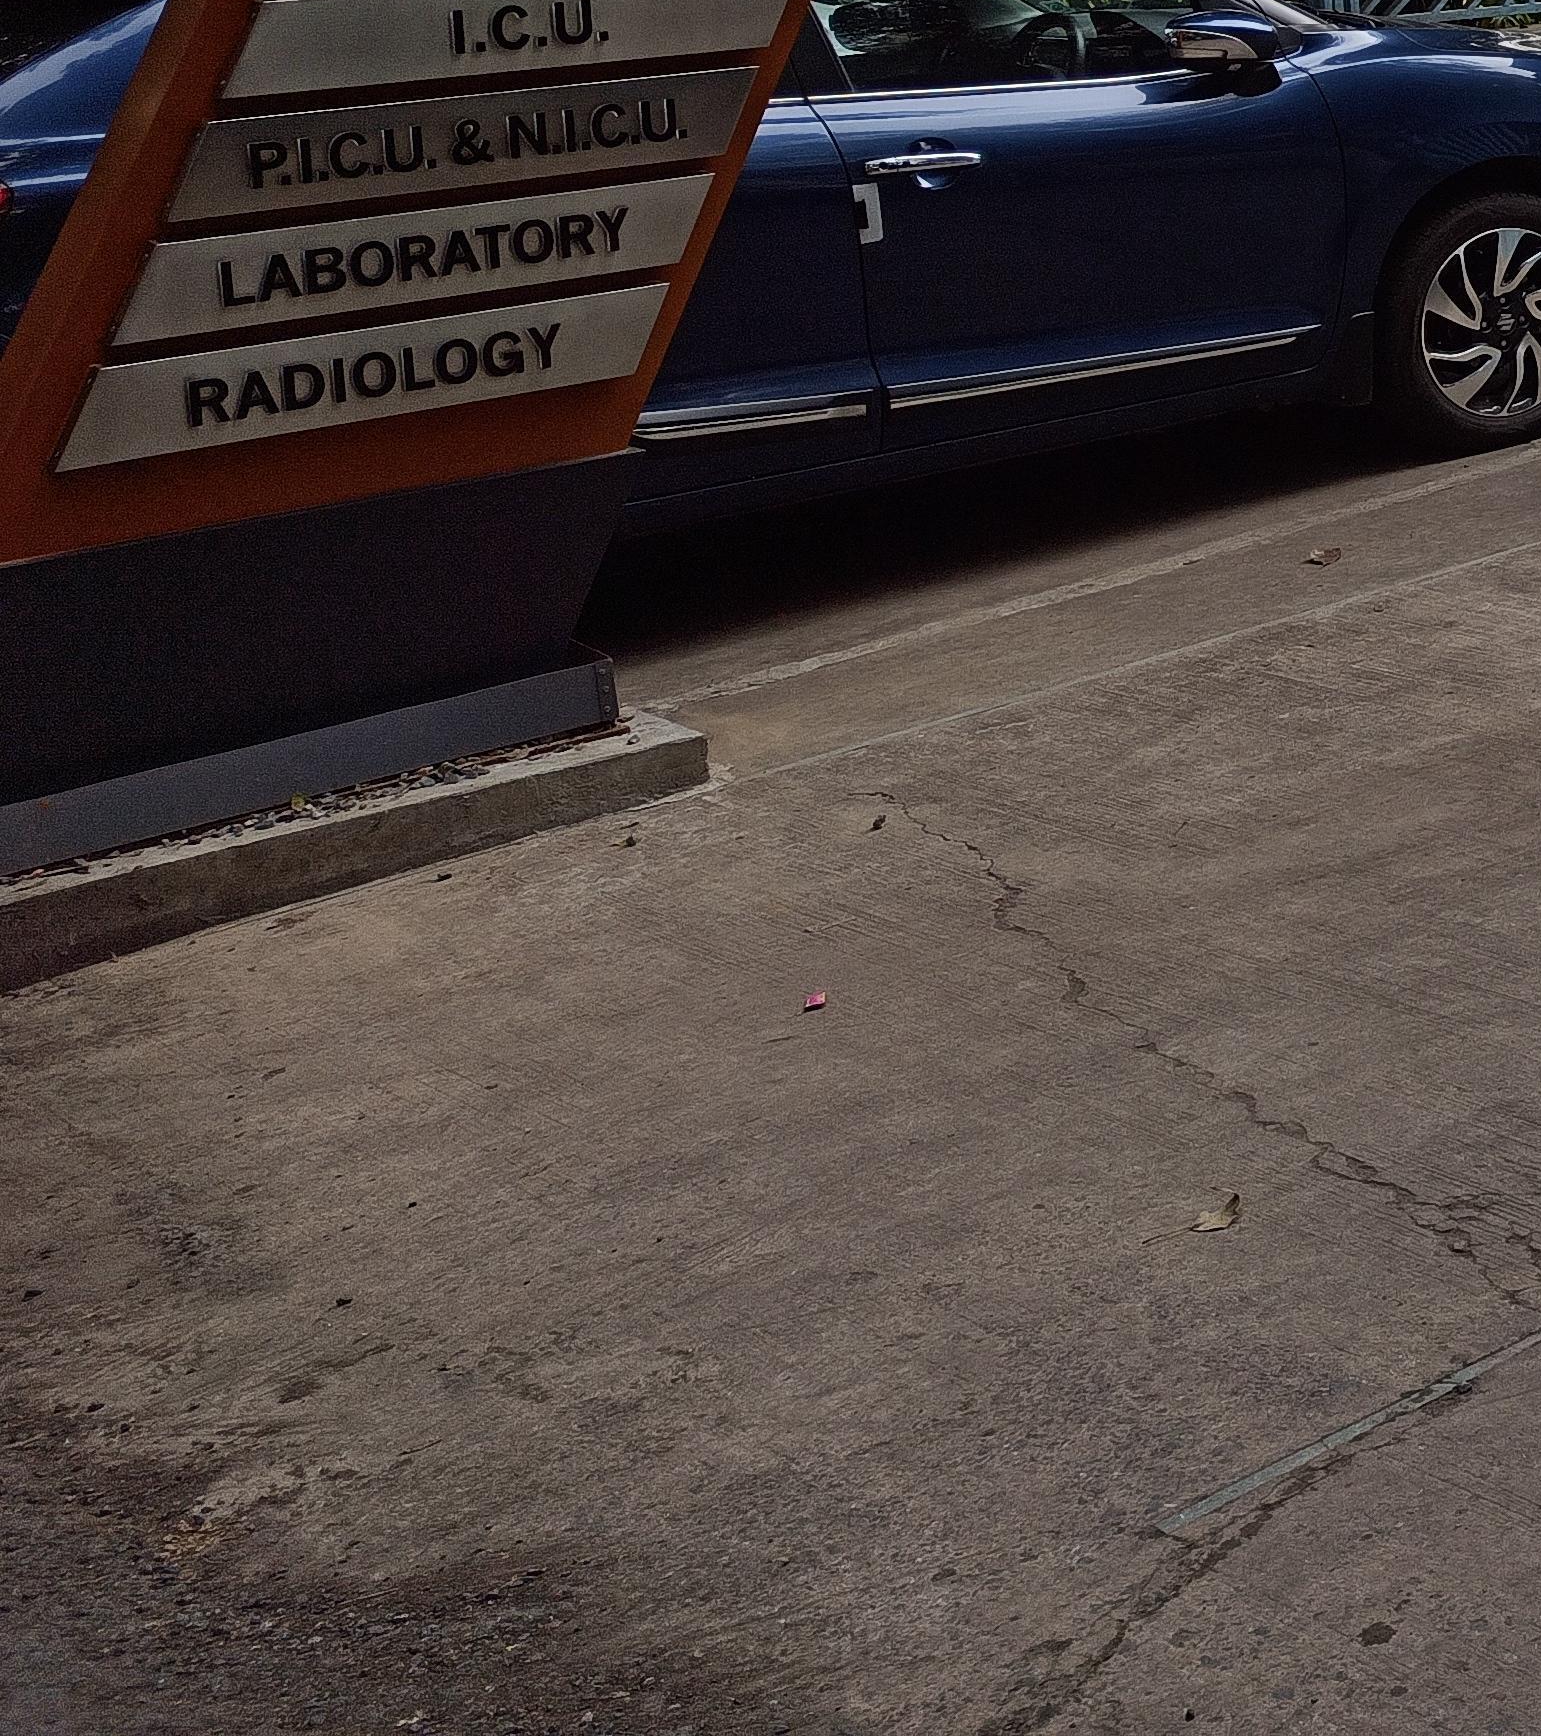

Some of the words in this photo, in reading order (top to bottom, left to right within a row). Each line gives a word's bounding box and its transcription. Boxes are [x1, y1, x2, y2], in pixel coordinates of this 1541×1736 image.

[246, 124, 438, 190] P.I.C.U.
[450, 117, 495, 165] &
[505, 97, 689, 160] N.I.C.U.
[217, 206, 630, 308] LABORATORY
[185, 321, 562, 428] RADIOLOGY
